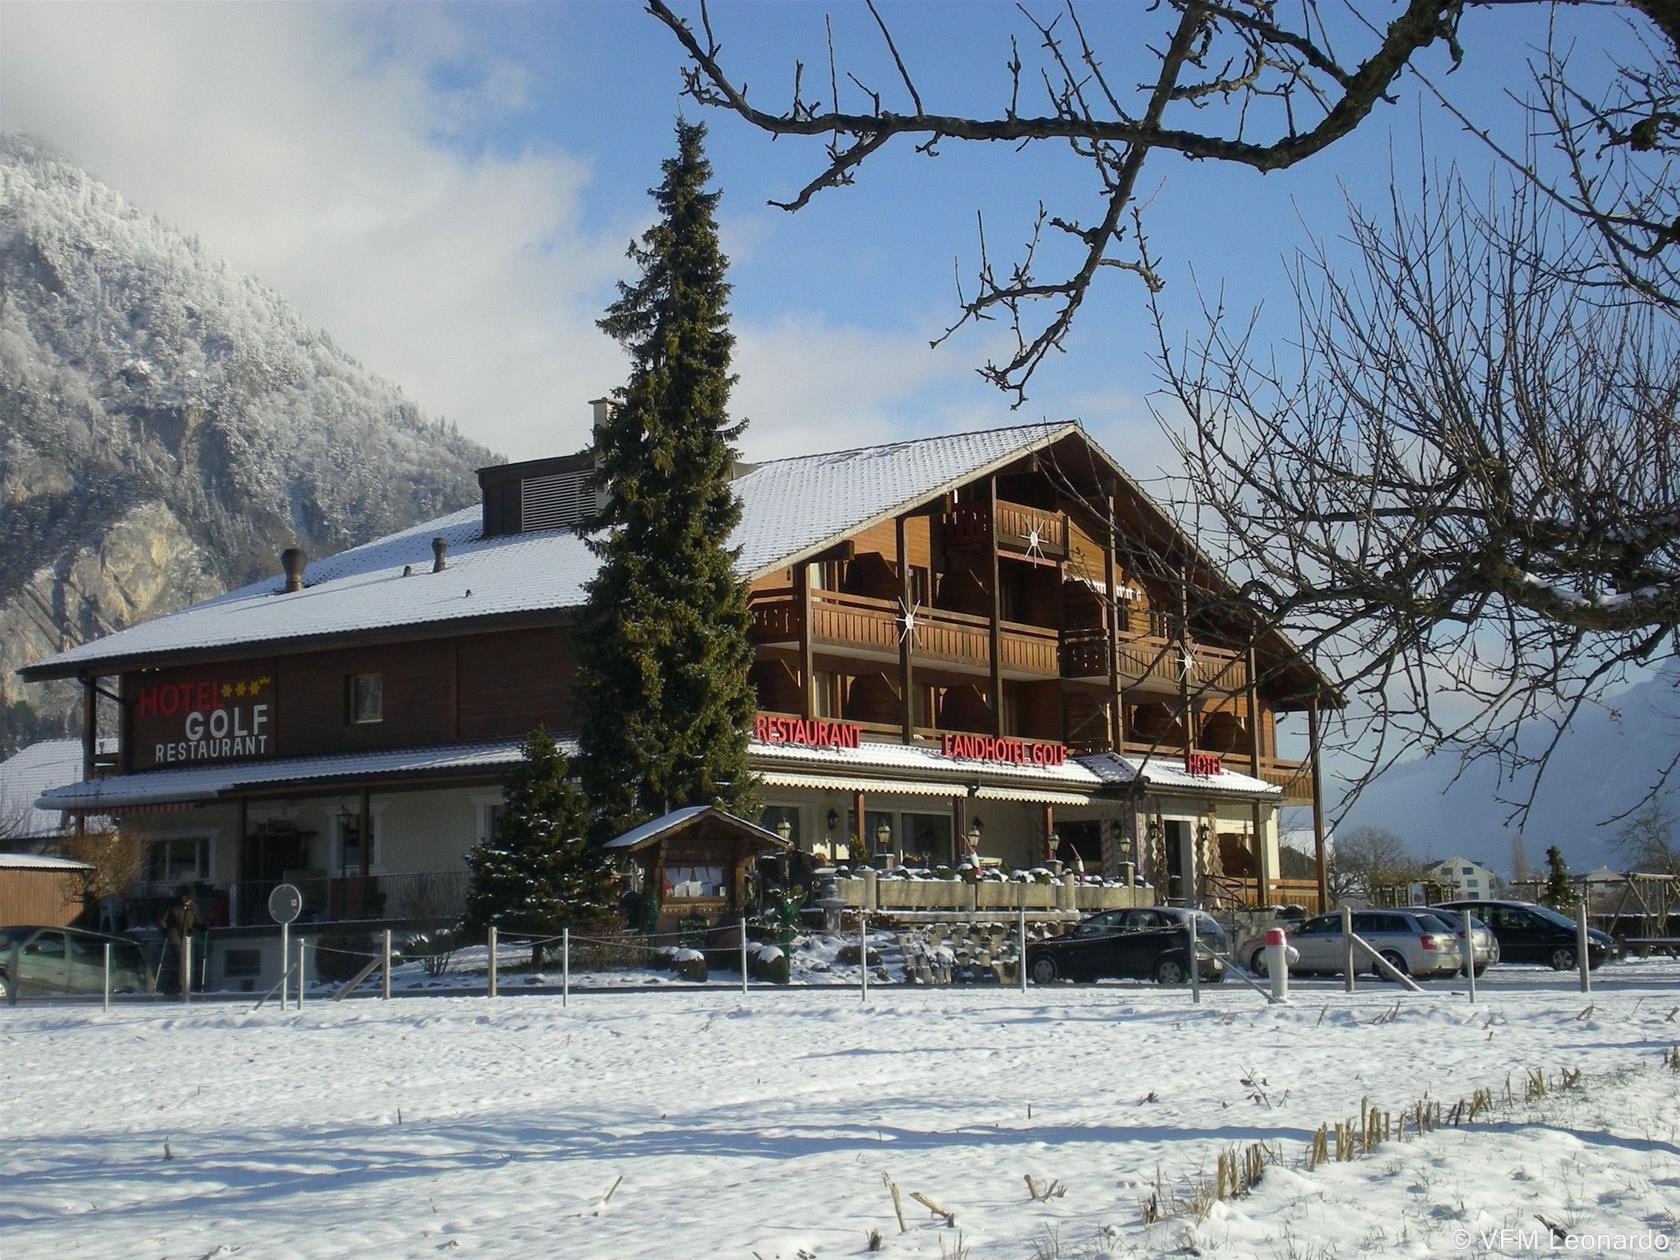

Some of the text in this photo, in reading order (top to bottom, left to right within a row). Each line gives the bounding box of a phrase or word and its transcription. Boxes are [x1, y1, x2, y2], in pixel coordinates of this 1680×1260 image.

[138, 680, 225, 717] HOTEL
[185, 704, 268, 741] GOLF
[755, 714, 863, 749] RESTAURANT
[155, 735, 268, 762] RESTAURANT
[943, 733, 1067, 767] LANDHOTEL GOLF
[1187, 753, 1224, 776] HOTEL
